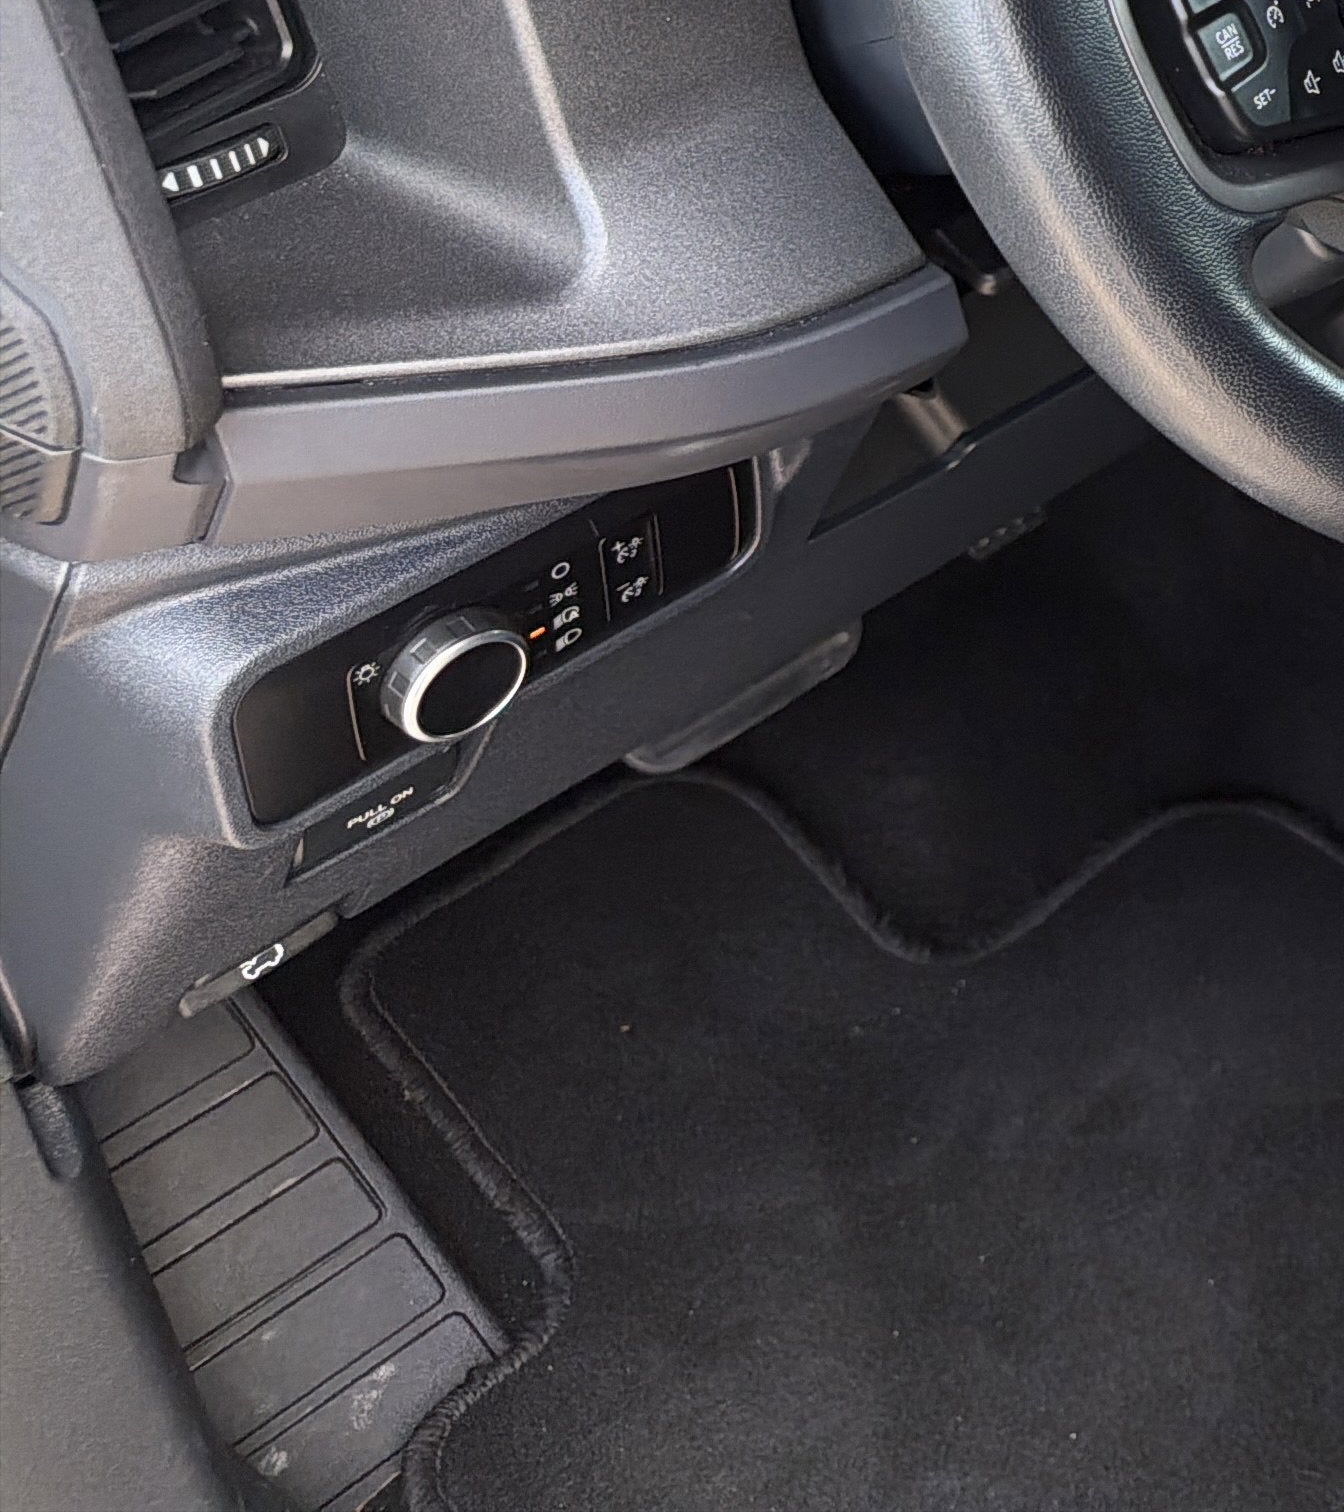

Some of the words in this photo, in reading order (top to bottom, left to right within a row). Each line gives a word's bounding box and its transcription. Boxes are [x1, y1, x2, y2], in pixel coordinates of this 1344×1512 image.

[1215, 23, 1239, 45] CAN
[1224, 40, 1245, 61] RES
[1253, 88, 1277, 110] SET-
[347, 804, 388, 829] PULL
[390, 786, 414, 805] ON
